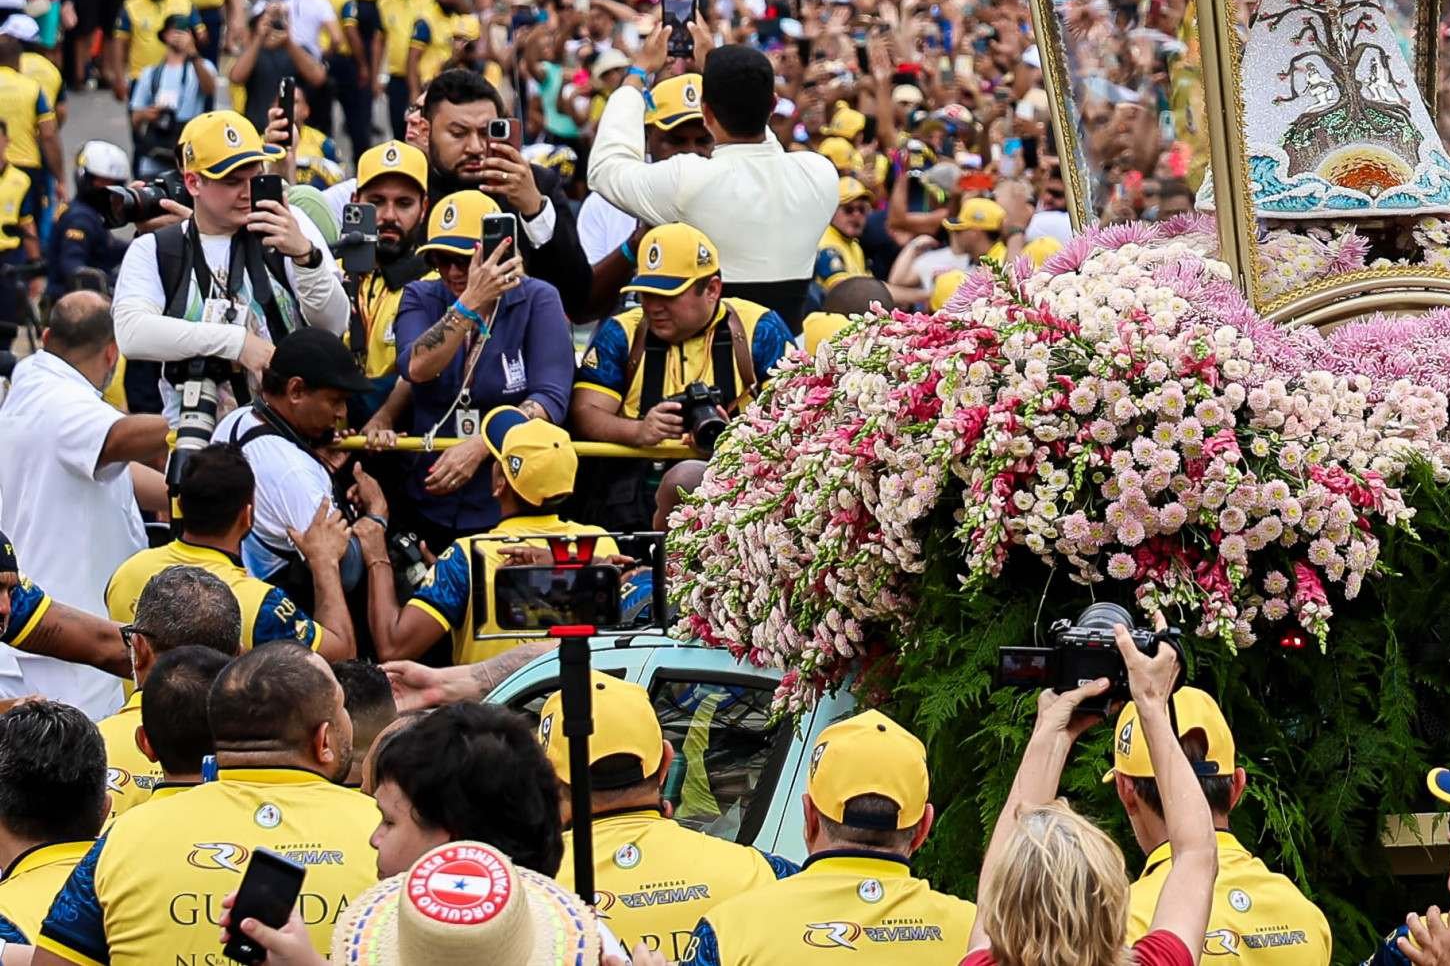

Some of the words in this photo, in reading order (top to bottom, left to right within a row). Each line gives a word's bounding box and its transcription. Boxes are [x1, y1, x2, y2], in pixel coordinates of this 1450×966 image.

[639, 880, 686, 890] EMPRESAS
[618, 884, 711, 909] REVEMAR
[169, 893, 354, 926] GUDA
[417, 896, 496, 922] ORGULHO
[882, 918, 923, 926] EMPRESAS
[863, 926, 943, 942] REVEMAR
[1241, 930, 1308, 949] REVEMAR
